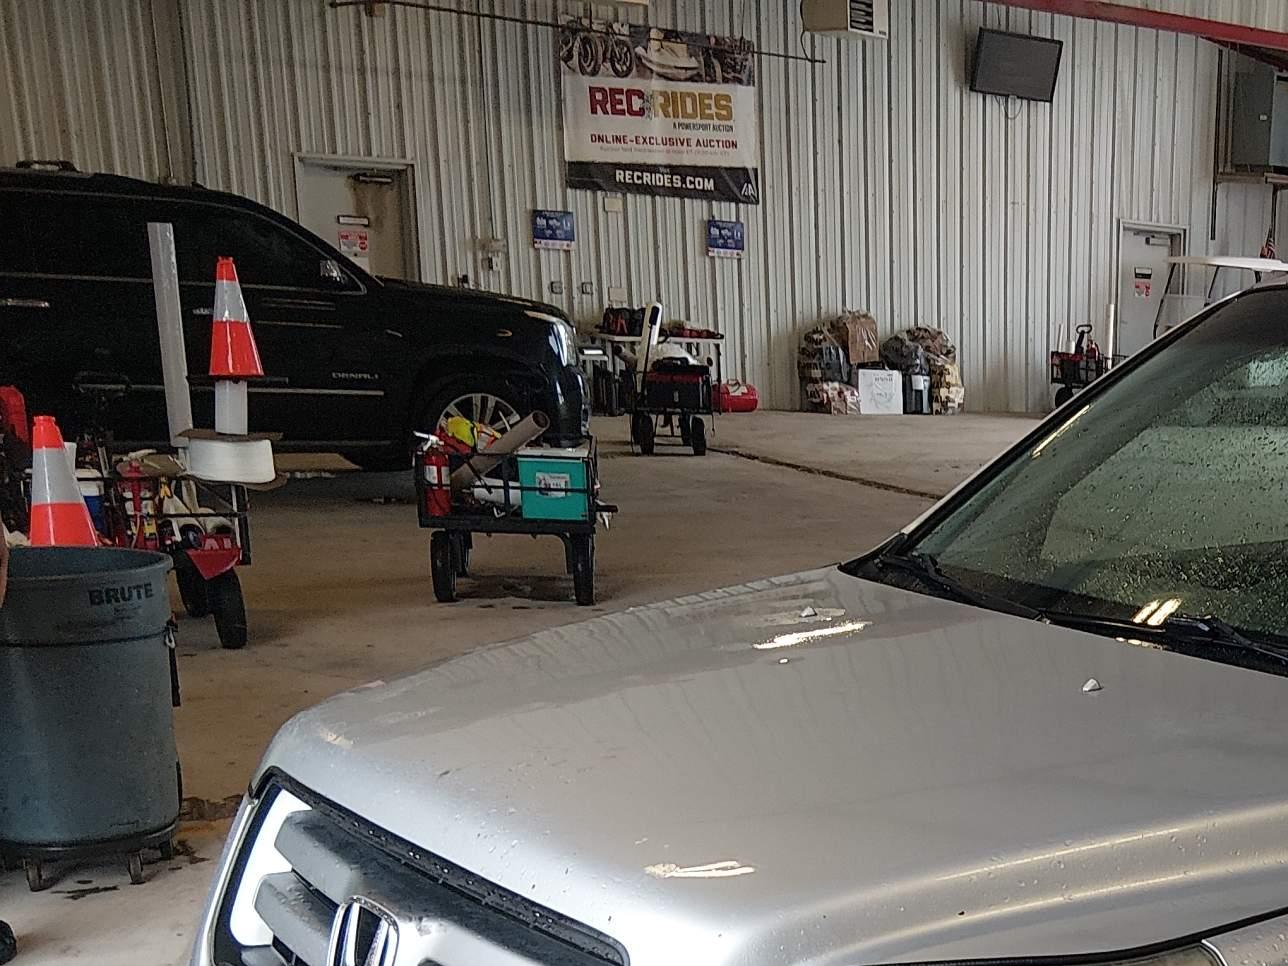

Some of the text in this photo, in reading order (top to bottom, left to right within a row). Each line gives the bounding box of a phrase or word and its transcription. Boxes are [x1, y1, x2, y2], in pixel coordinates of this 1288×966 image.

[589, 86, 733, 121] REC RIDES
[678, 122, 711, 131] POWERSPORT
[713, 124, 733, 133] AUCTION
[590, 133, 738, 150] ONLINE-EXCLUSIVE AUCTION
[615, 169, 715, 191] RECRIDES.COM
[88, 582, 154, 606] BRUTE
